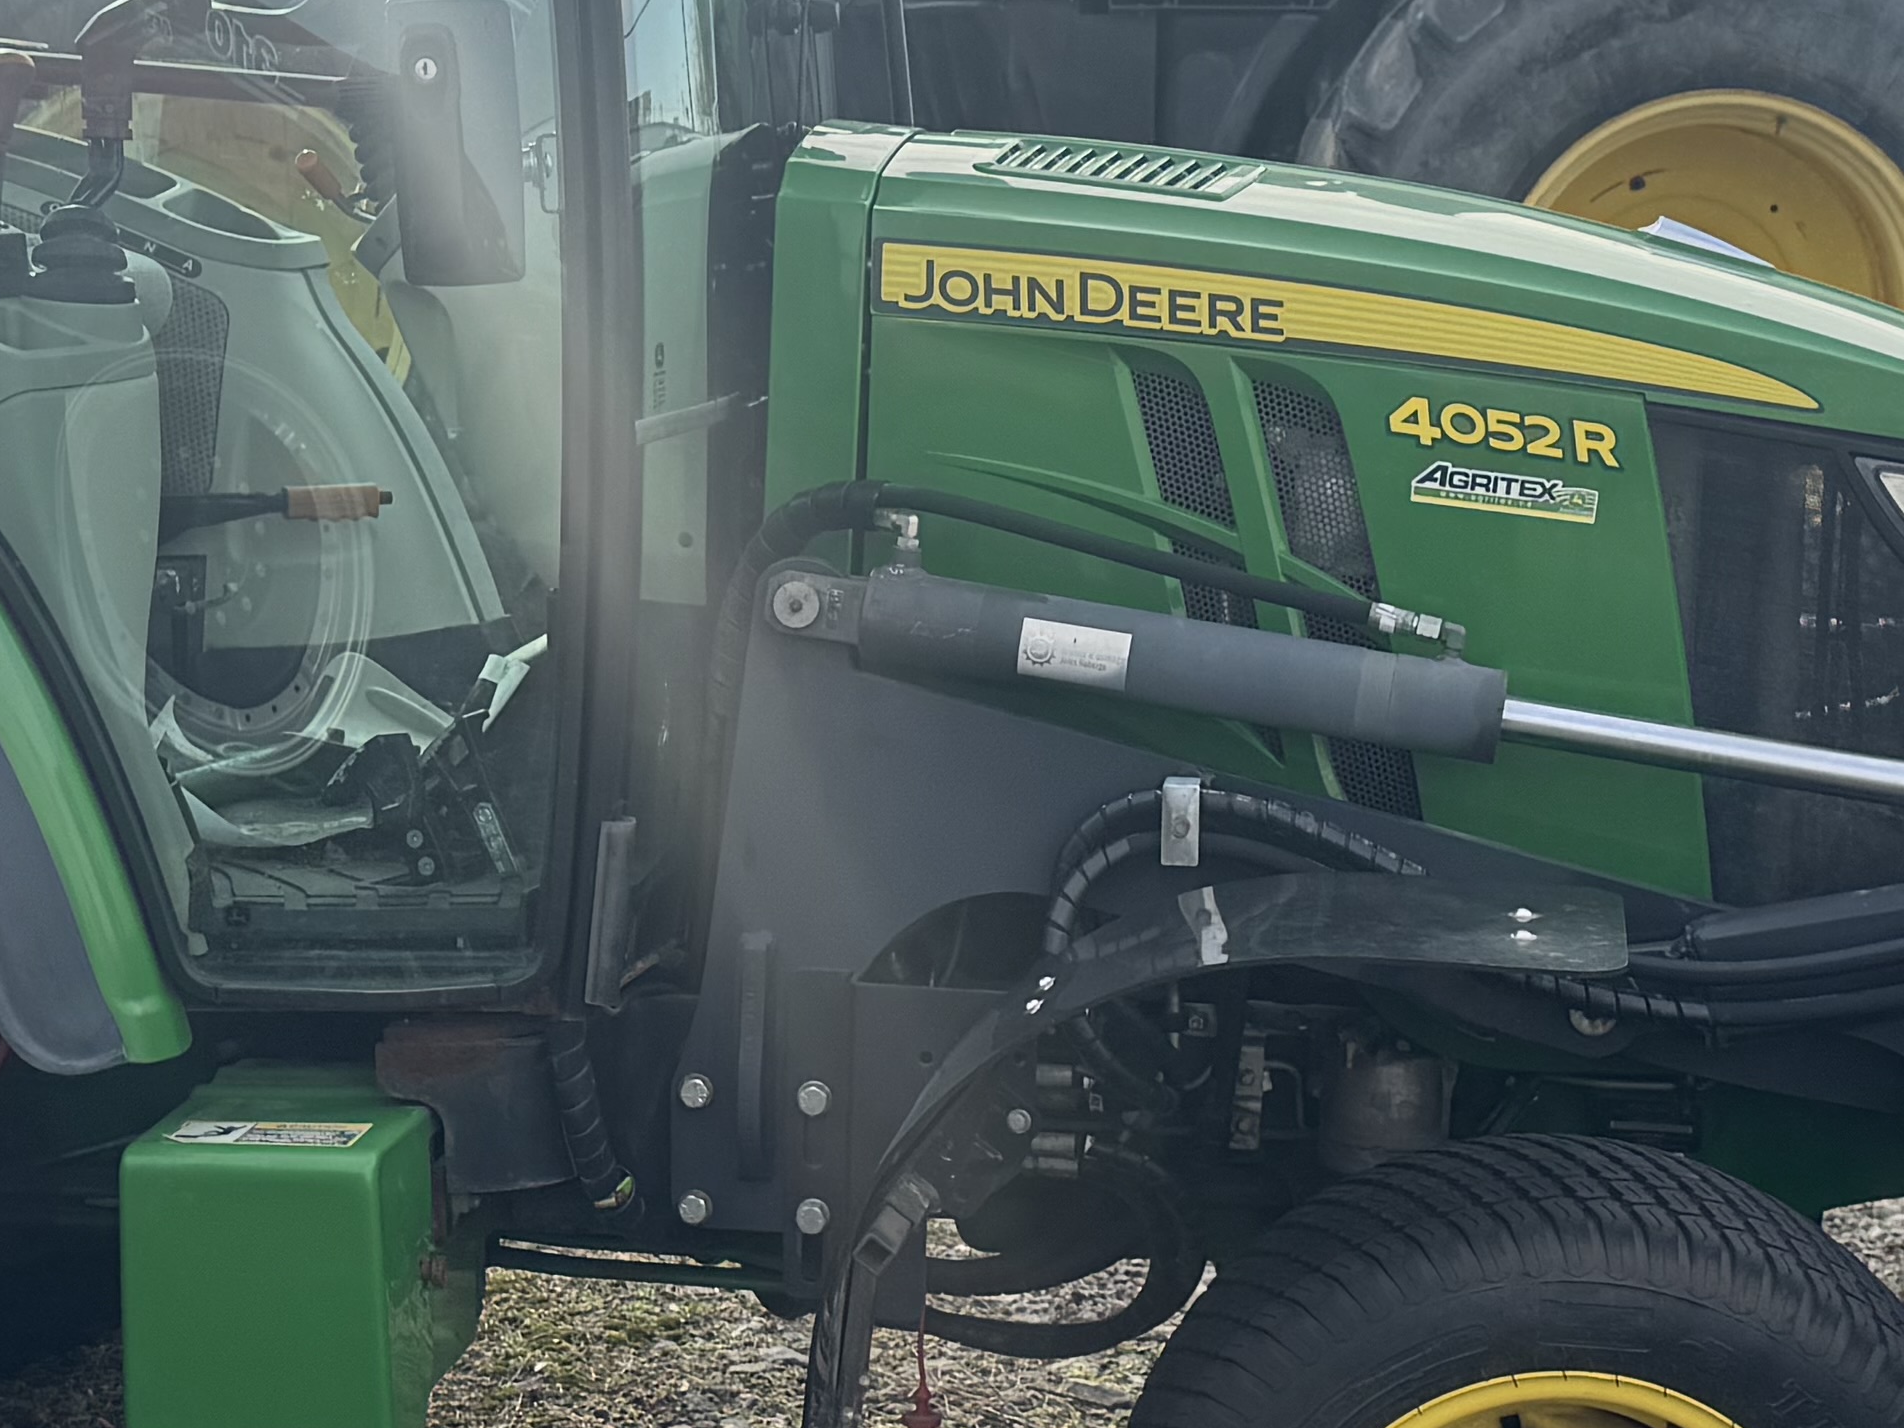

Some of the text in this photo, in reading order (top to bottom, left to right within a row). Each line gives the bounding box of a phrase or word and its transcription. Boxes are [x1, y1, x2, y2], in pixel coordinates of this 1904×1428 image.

[904, 259, 1285, 336] JOHN DEERE
[1389, 396, 1620, 468] 4052 R
[1416, 464, 1559, 501] AGRITEX
